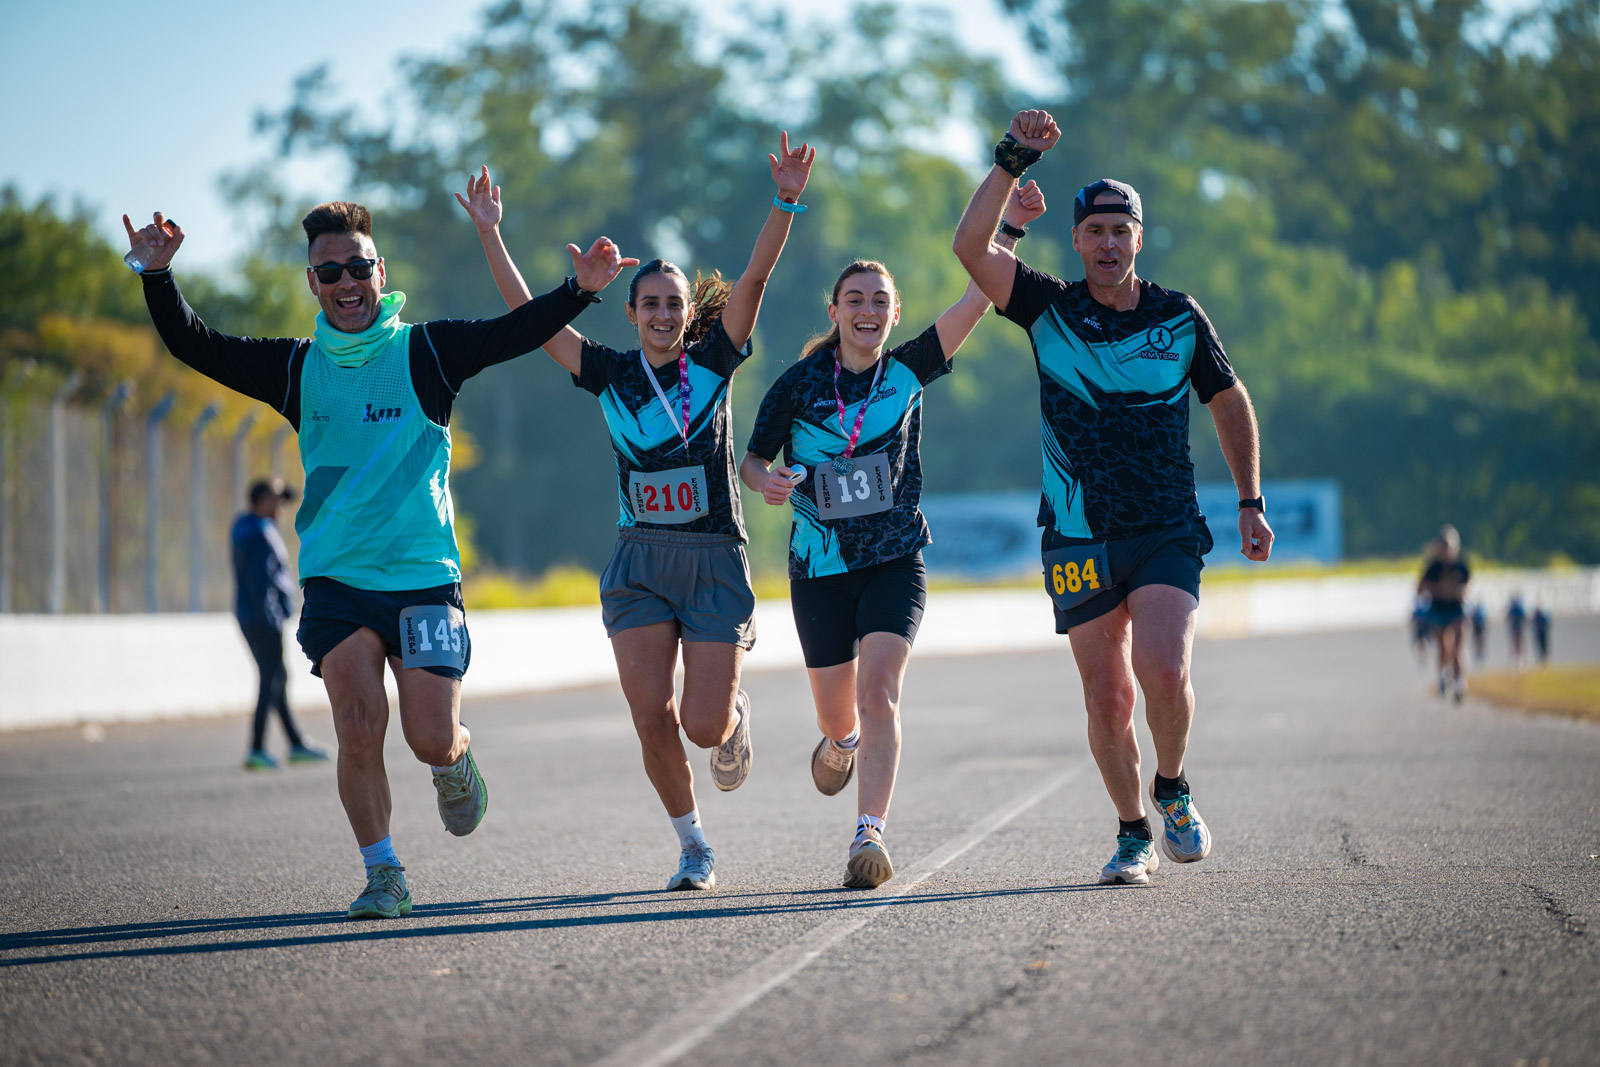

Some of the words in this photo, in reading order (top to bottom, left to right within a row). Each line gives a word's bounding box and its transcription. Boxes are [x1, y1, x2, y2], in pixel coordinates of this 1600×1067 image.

[634, 482, 645, 513] TIEMPO
[643, 482, 693, 512] 210
[691, 477, 701, 512] EXACTO
[821, 473, 831, 508] TIEMPO
[838, 470, 871, 503] 13
[875, 465, 885, 501] EXACTO
[1052, 558, 1100, 595] 684
[405, 617, 416, 655] TIEMPO
[418, 618, 461, 653] 145
